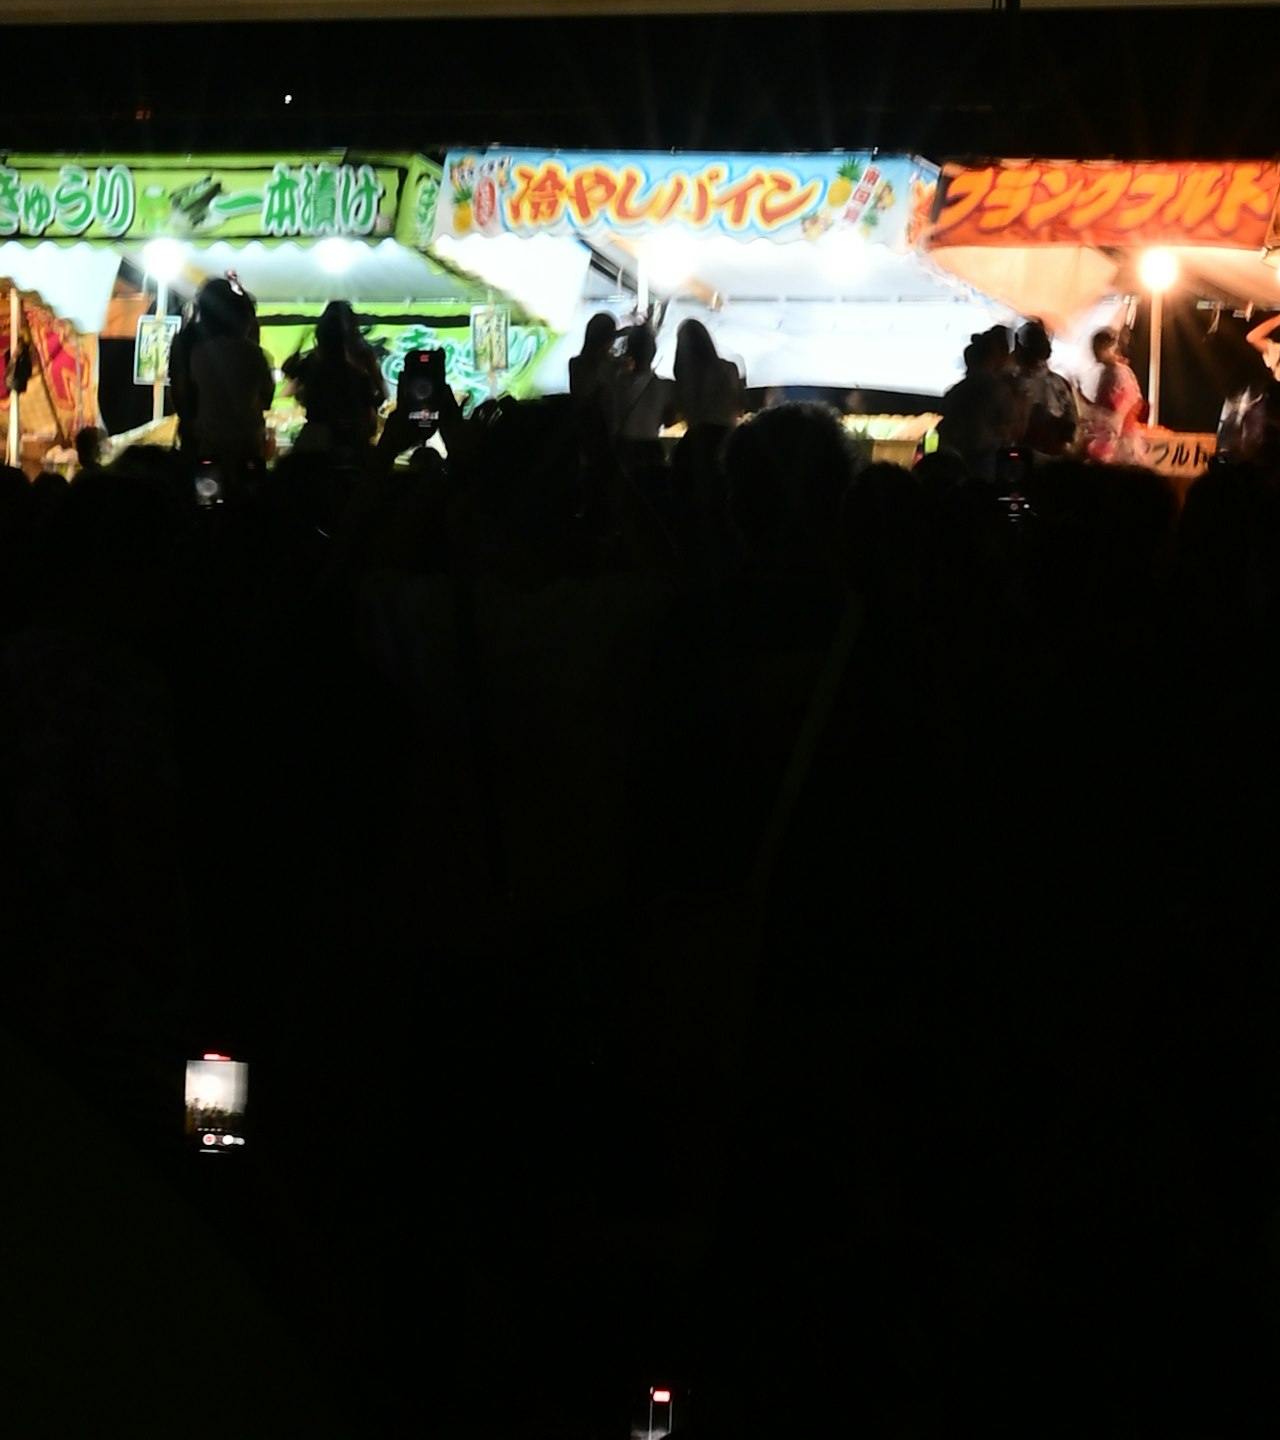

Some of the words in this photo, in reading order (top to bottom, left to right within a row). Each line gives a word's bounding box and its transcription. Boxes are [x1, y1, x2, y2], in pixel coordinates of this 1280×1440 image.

[0, 164, 134, 237] きゅうり
[508, 162, 819, 227] 冷やしパイン
[939, 166, 1274, 236] フランクフルト
[1144, 441, 1209, 469] フルト
